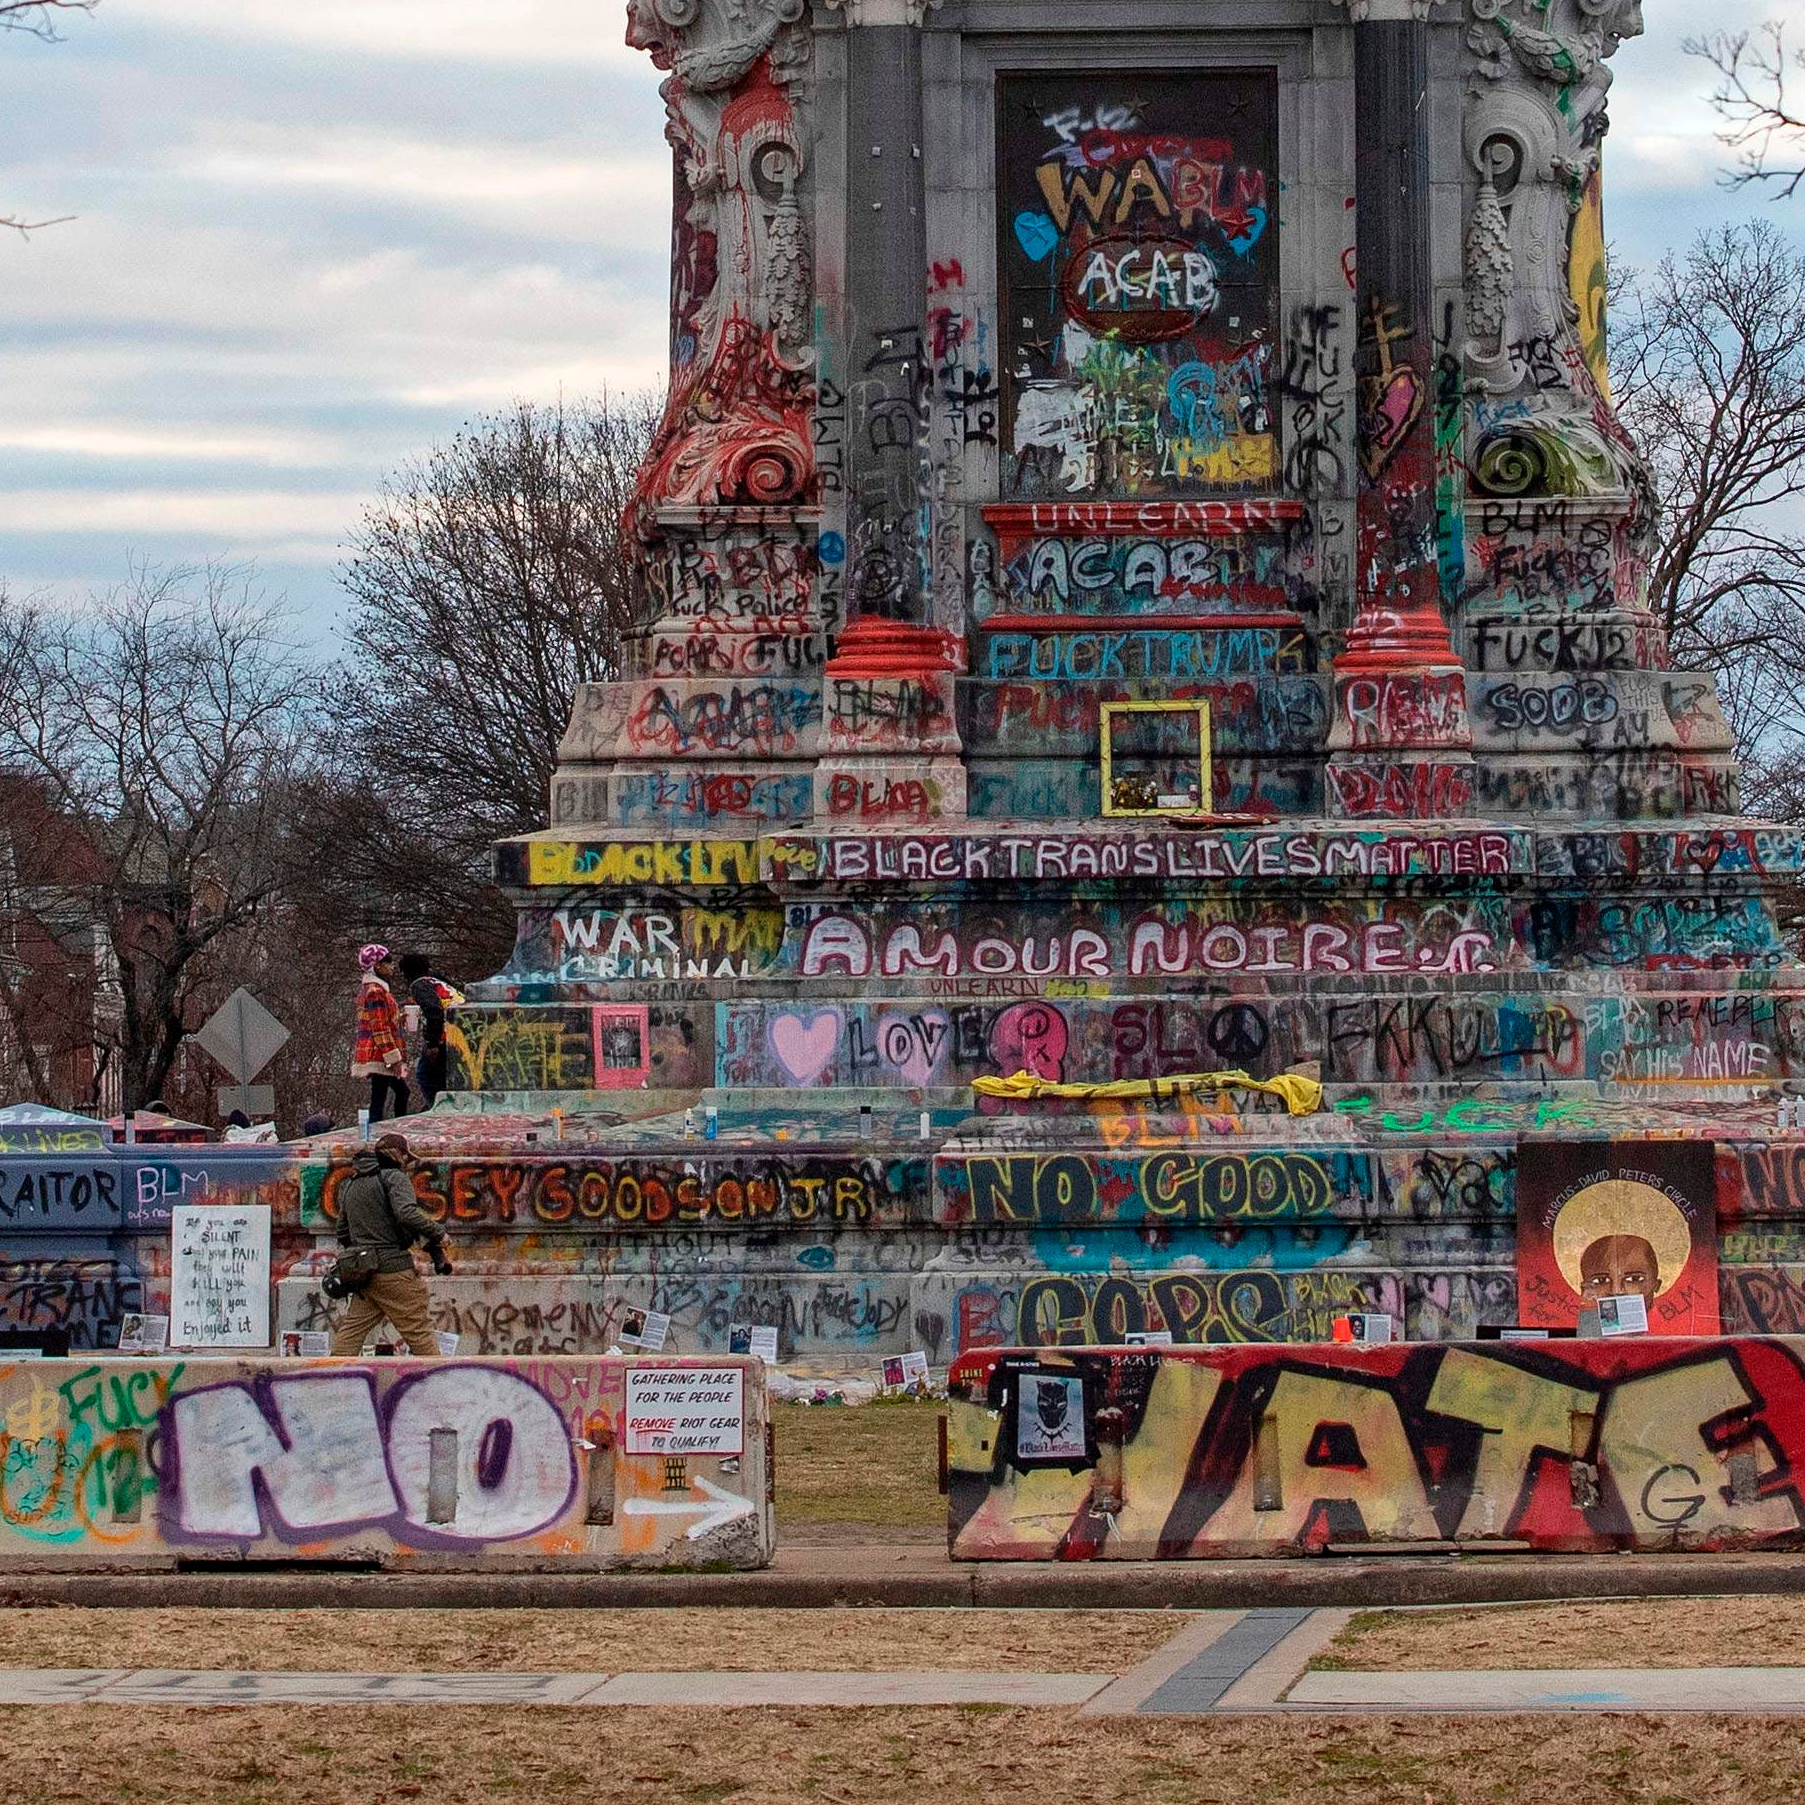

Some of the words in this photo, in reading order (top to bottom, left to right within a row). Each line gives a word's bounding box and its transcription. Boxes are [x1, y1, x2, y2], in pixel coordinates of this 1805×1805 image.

[1078, 249, 1218, 309] ACAB
[1032, 501, 1277, 534] UNLEARN
[1481, 499, 1567, 538] BLM
[1028, 539, 1220, 600] ACAB
[1473, 616, 1586, 672] FUCK
[551, 909, 681, 954] WAR
[799, 915, 1112, 976] AMOUR
[1129, 918, 1411, 976] NOIRE
[559, 954, 753, 982] CRIMINAL
[1600, 1046, 1645, 1082] SAY
[1692, 1039, 1771, 1080] NAME
[136, 1166, 210, 1208] BLM
[321, 1165, 522, 1223] CSEY
[534, 1165, 780, 1223] GOODSON
[789, 1177, 867, 1220] JR
[965, 1151, 1097, 1222] NO
[1137, 1149, 1333, 1219] GOOD
[1618, 1167, 1664, 1189] PETERS
[1663, 1184, 1698, 1221] CIRCLE
[201, 1230, 243, 1245] SILENT
[207, 1219, 224, 1231] you
[227, 1297, 247, 1314] you
[1016, 1269, 1295, 1344] COPS
[1658, 1283, 1705, 1322] BLM
[183, 1316, 232, 1342] Enjoyed
[238, 1315, 253, 1334] it
[631, 1373, 697, 1386] GATHERING
[699, 1372, 737, 1385] PLACE
[635, 1391, 661, 1404] FOR
[663, 1391, 686, 1403] THE
[688, 1390, 734, 1404] PEOPLE
[629, 1417, 677, 1430] REMOVE
[680, 1417, 707, 1429] RIOT
[709, 1417, 741, 1430] GEAR
[651, 1436, 667, 1448] TO
[669, 1435, 721, 1450] QUALIFY!
[156, 1362, 580, 1554] NO
